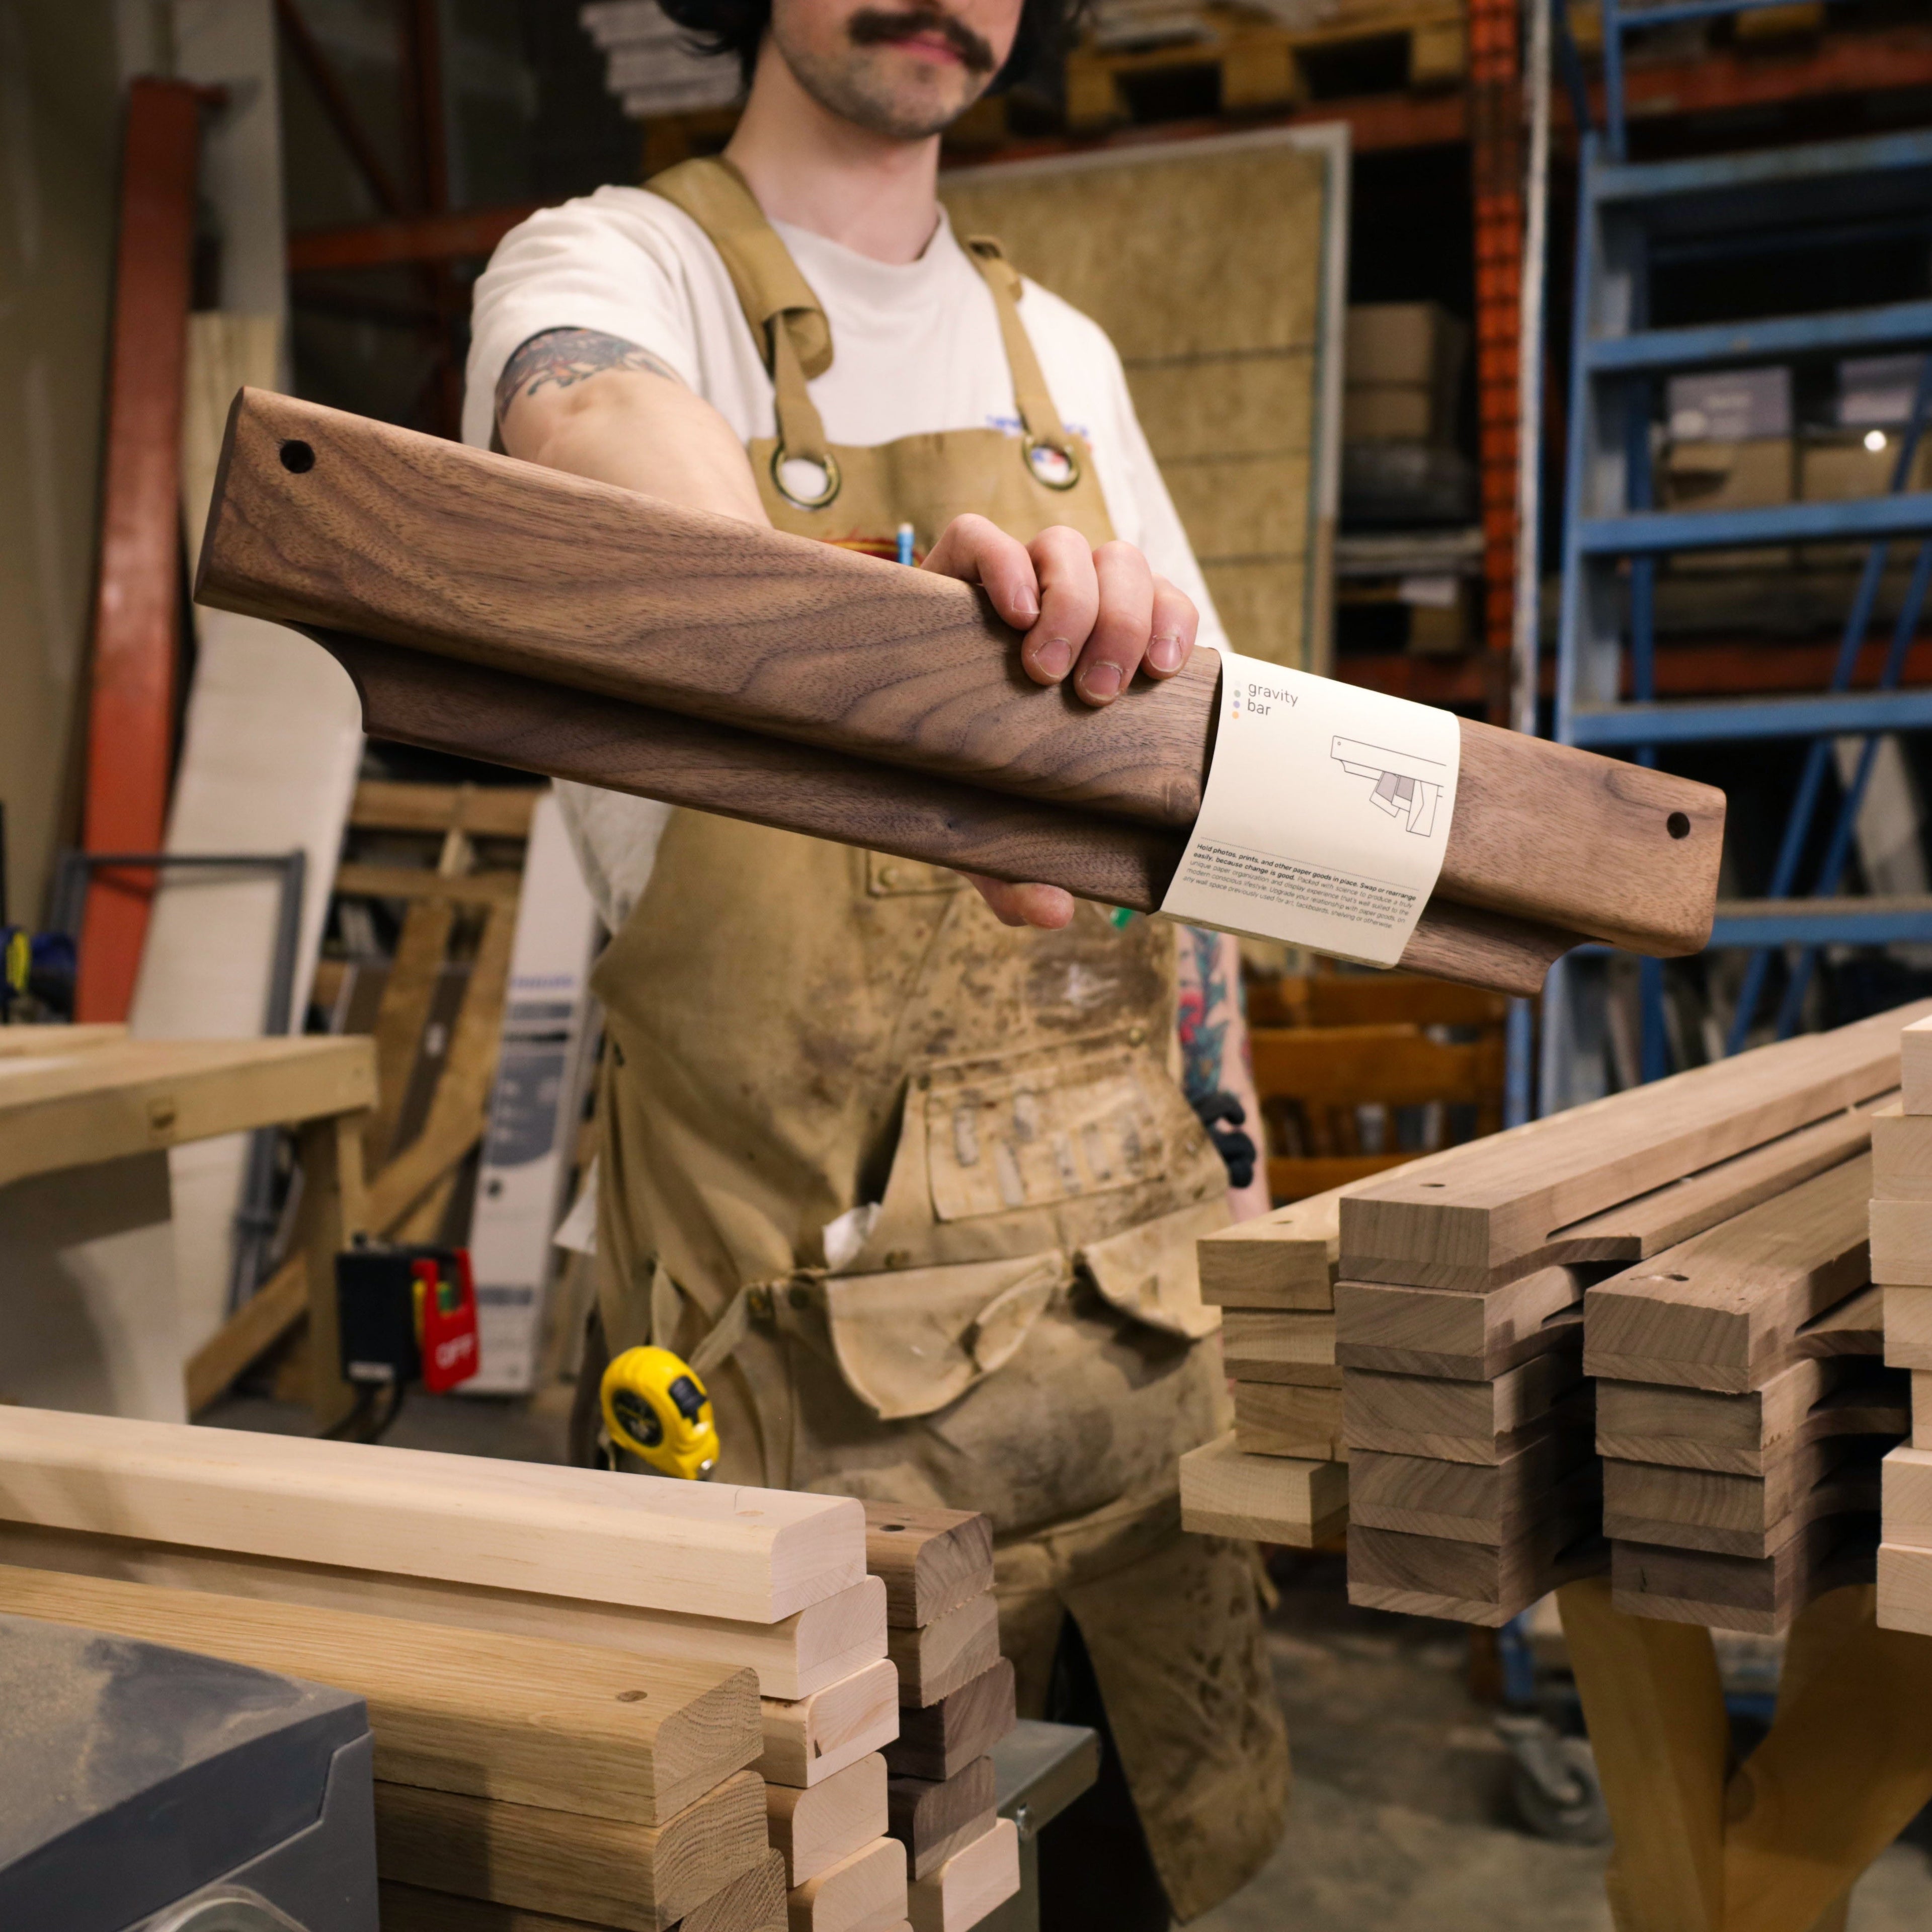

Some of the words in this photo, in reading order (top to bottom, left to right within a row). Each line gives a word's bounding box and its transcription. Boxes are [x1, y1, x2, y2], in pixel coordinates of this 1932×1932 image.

[1248, 698, 1271, 715] bar
[1249, 684, 1298, 707] gravity
[1216, 857, 1243, 867] because
[1245, 864, 1269, 873] change
[1297, 876, 1320, 885] Packed
[1336, 886, 1358, 894] science
[1367, 894, 1393, 902] produce
[1400, 900, 1413, 908] truly
[1360, 882, 1378, 892] Swap
[1386, 890, 1416, 900] rearrange
[435, 1333, 472, 1370] OFF
